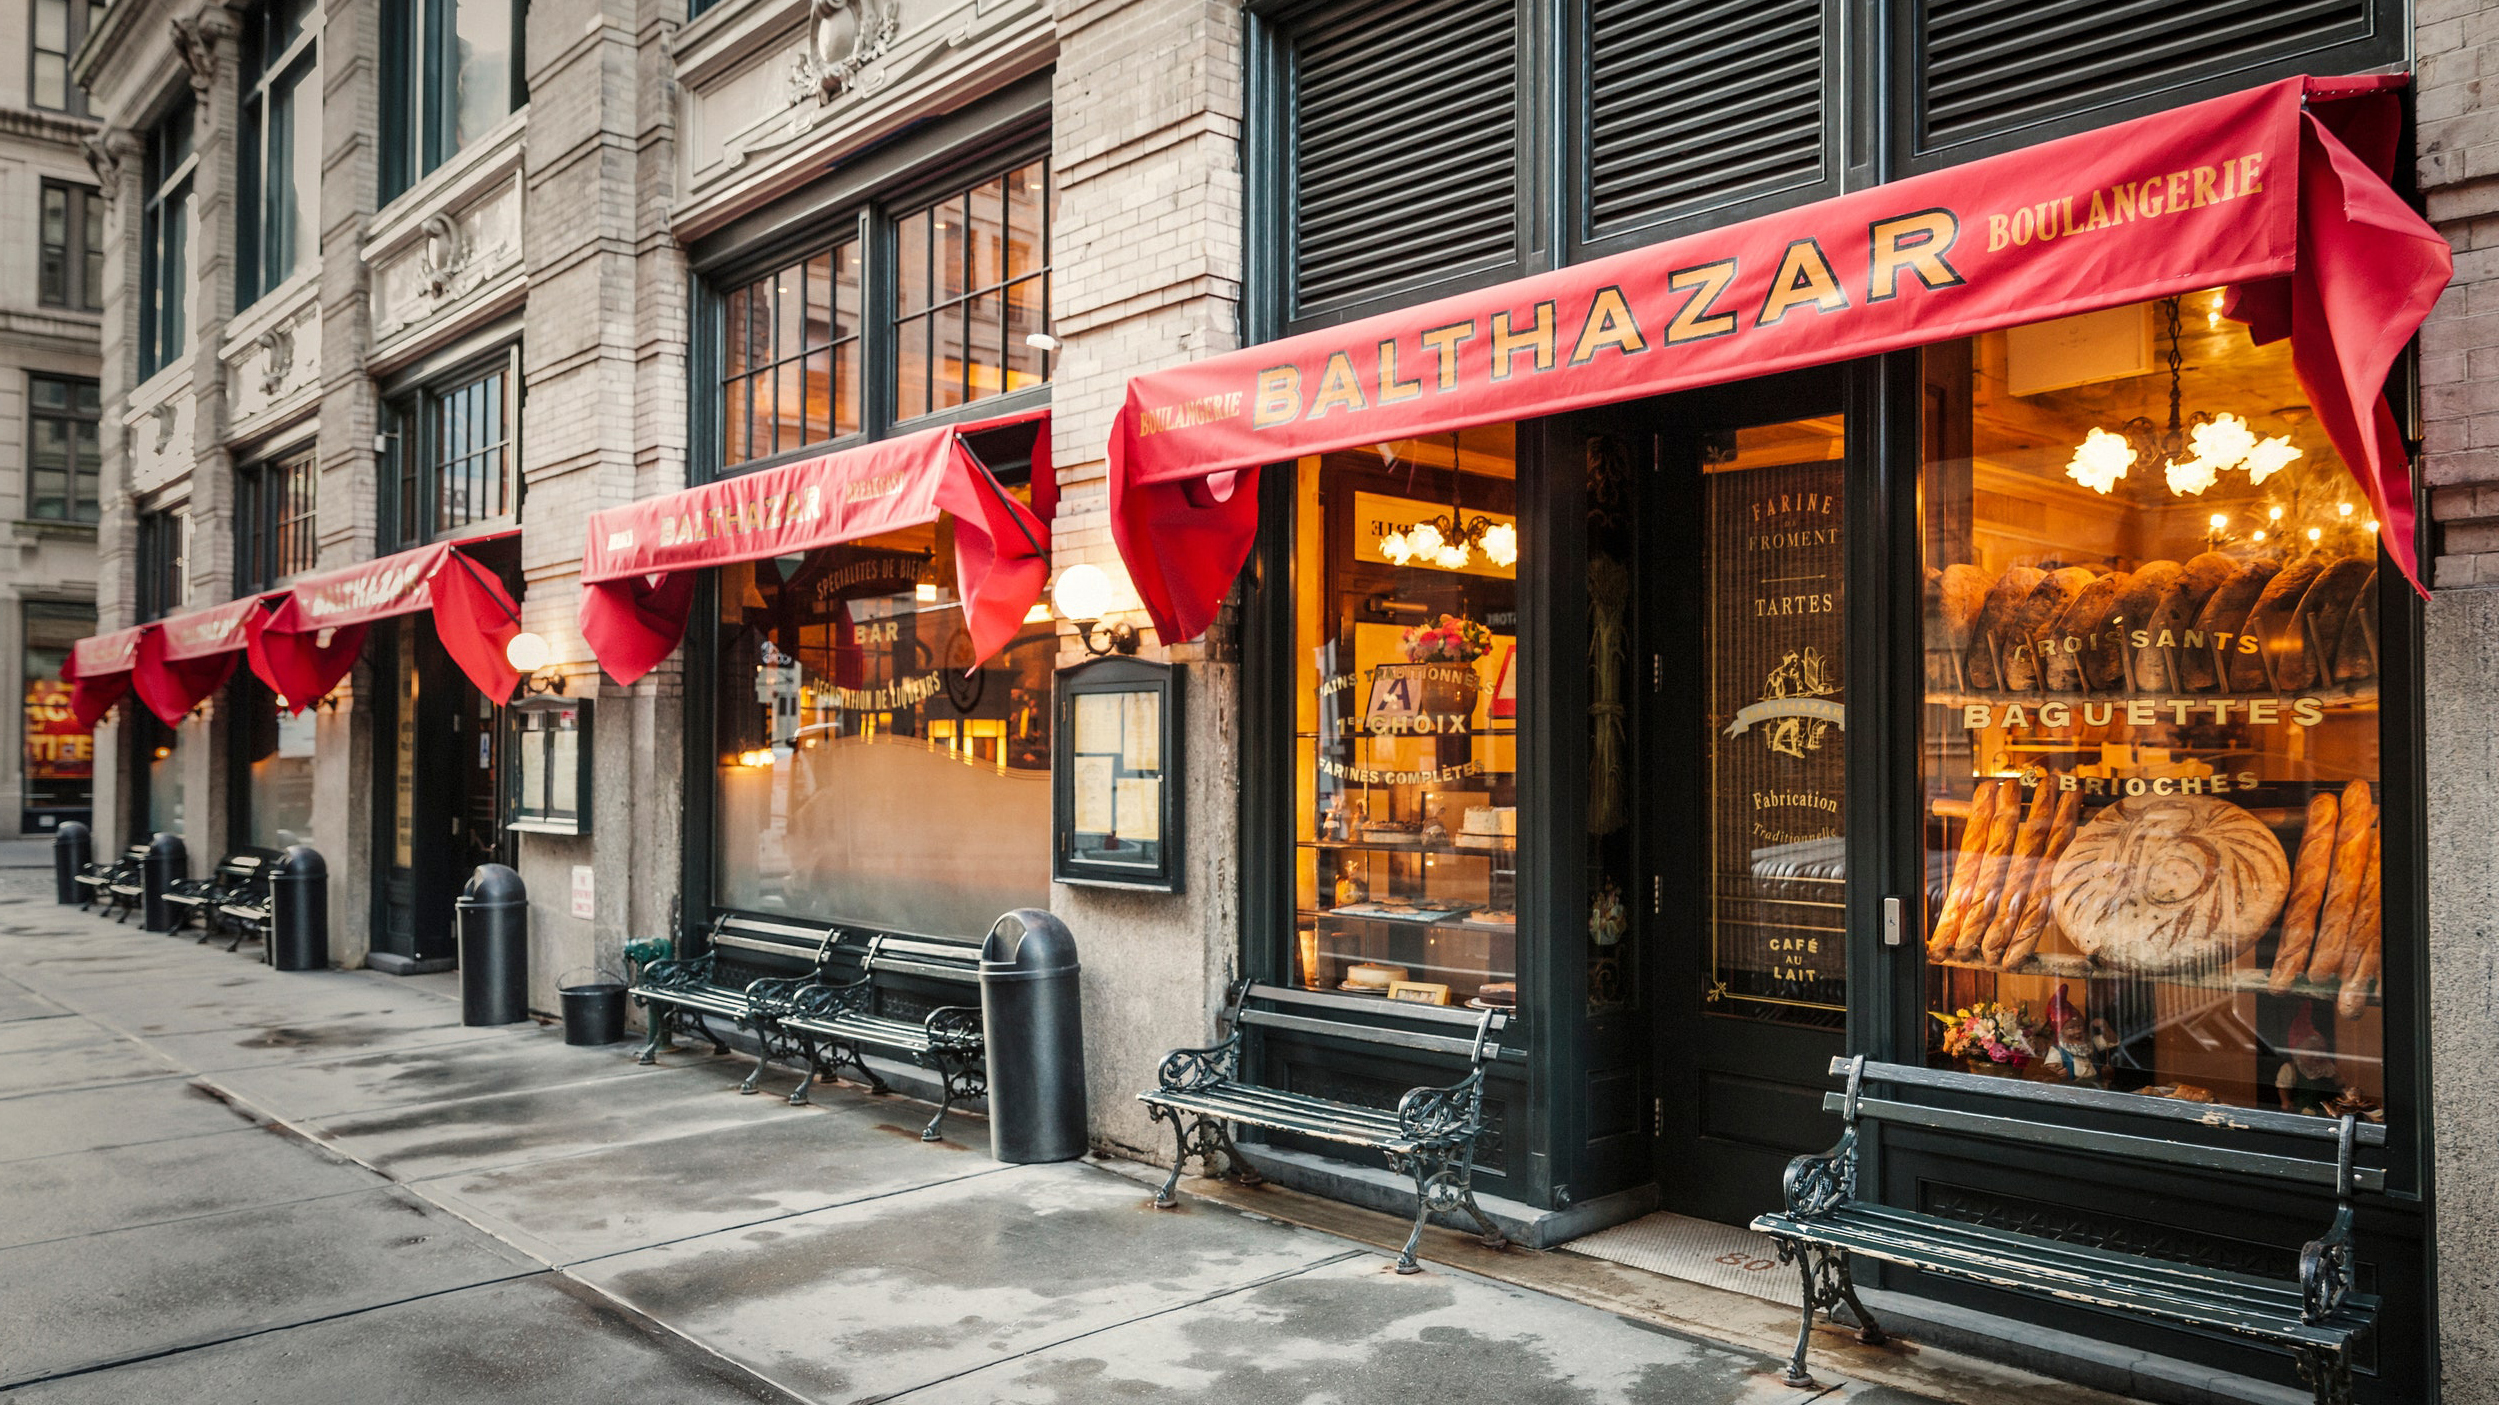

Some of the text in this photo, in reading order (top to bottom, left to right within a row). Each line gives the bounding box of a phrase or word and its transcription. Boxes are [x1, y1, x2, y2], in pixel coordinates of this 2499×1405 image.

[1139, 152, 2264, 437] BOULANGERIE BALTHAZAR BOULANGERIE
[660, 484, 821, 547] BALTHAZAR
[847, 471, 905, 504] BREAKFAST
[1752, 493, 1833, 521] FARINE
[1748, 528, 1837, 551] FROMENT
[882, 558, 894, 579] DE
[1755, 594, 1832, 616] TARTES
[854, 622, 899, 644] BAR
[876, 689, 888, 710] DE
[889, 670, 941, 710] LIQUEURS
[1314, 667, 1495, 698] PAINS TRADITIONNELS
[1746, 701, 1844, 720] BALTHAZAR
[1963, 696, 2325, 730] BAGUETTES
[1370, 714, 1467, 735] CHOIX
[1318, 757, 1485, 785] FARINES COMPLÈTES
[2018, 768, 2259, 796] & BRIOCHES
[1753, 789, 1837, 813] Fabrication
[1752, 822, 1836, 844] Traditionnelle
[1769, 937, 1818, 953] CAFÉ
[1785, 955, 1802, 966] AU
[1773, 966, 1815, 982] LAIT
[1715, 1252, 1775, 1271] 80
